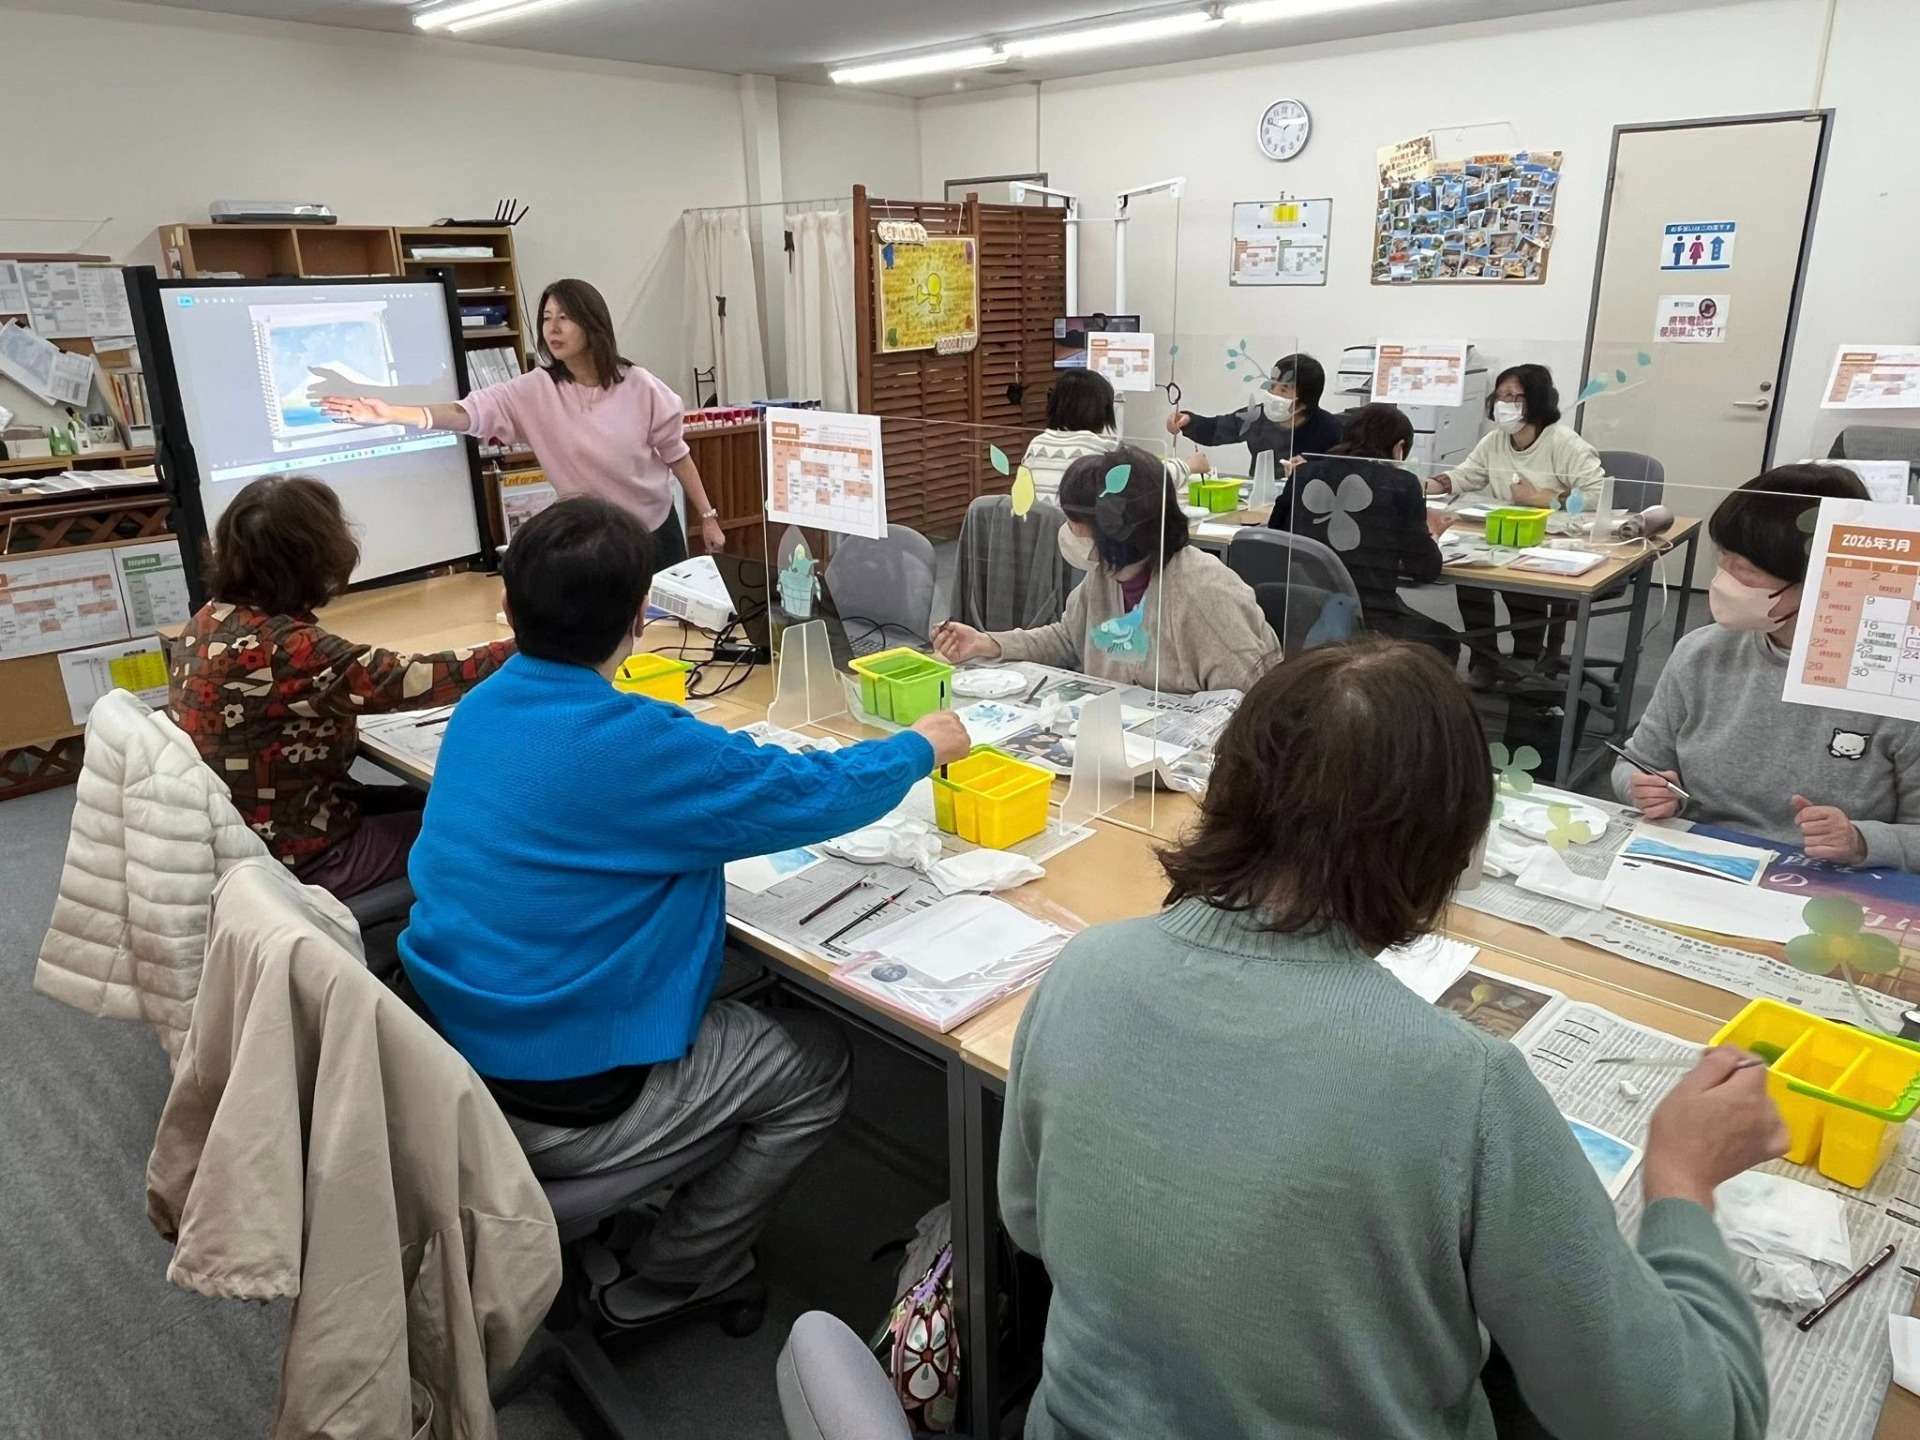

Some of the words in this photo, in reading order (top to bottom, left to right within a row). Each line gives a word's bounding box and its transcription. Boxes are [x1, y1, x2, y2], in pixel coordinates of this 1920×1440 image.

[1841, 534, 1911, 553] 2026年3月
[1870, 572, 1880, 581] 2
[1866, 596, 1876, 605] 9
[1818, 615, 1833, 625] 15
[1863, 620, 1879, 630] 16
[1810, 638, 1828, 647] 22
[1856, 643, 1873, 653] 23
[1902, 650, 1920, 660] 24
[1851, 666, 1870, 677] 30
[1897, 673, 1913, 684] 31
